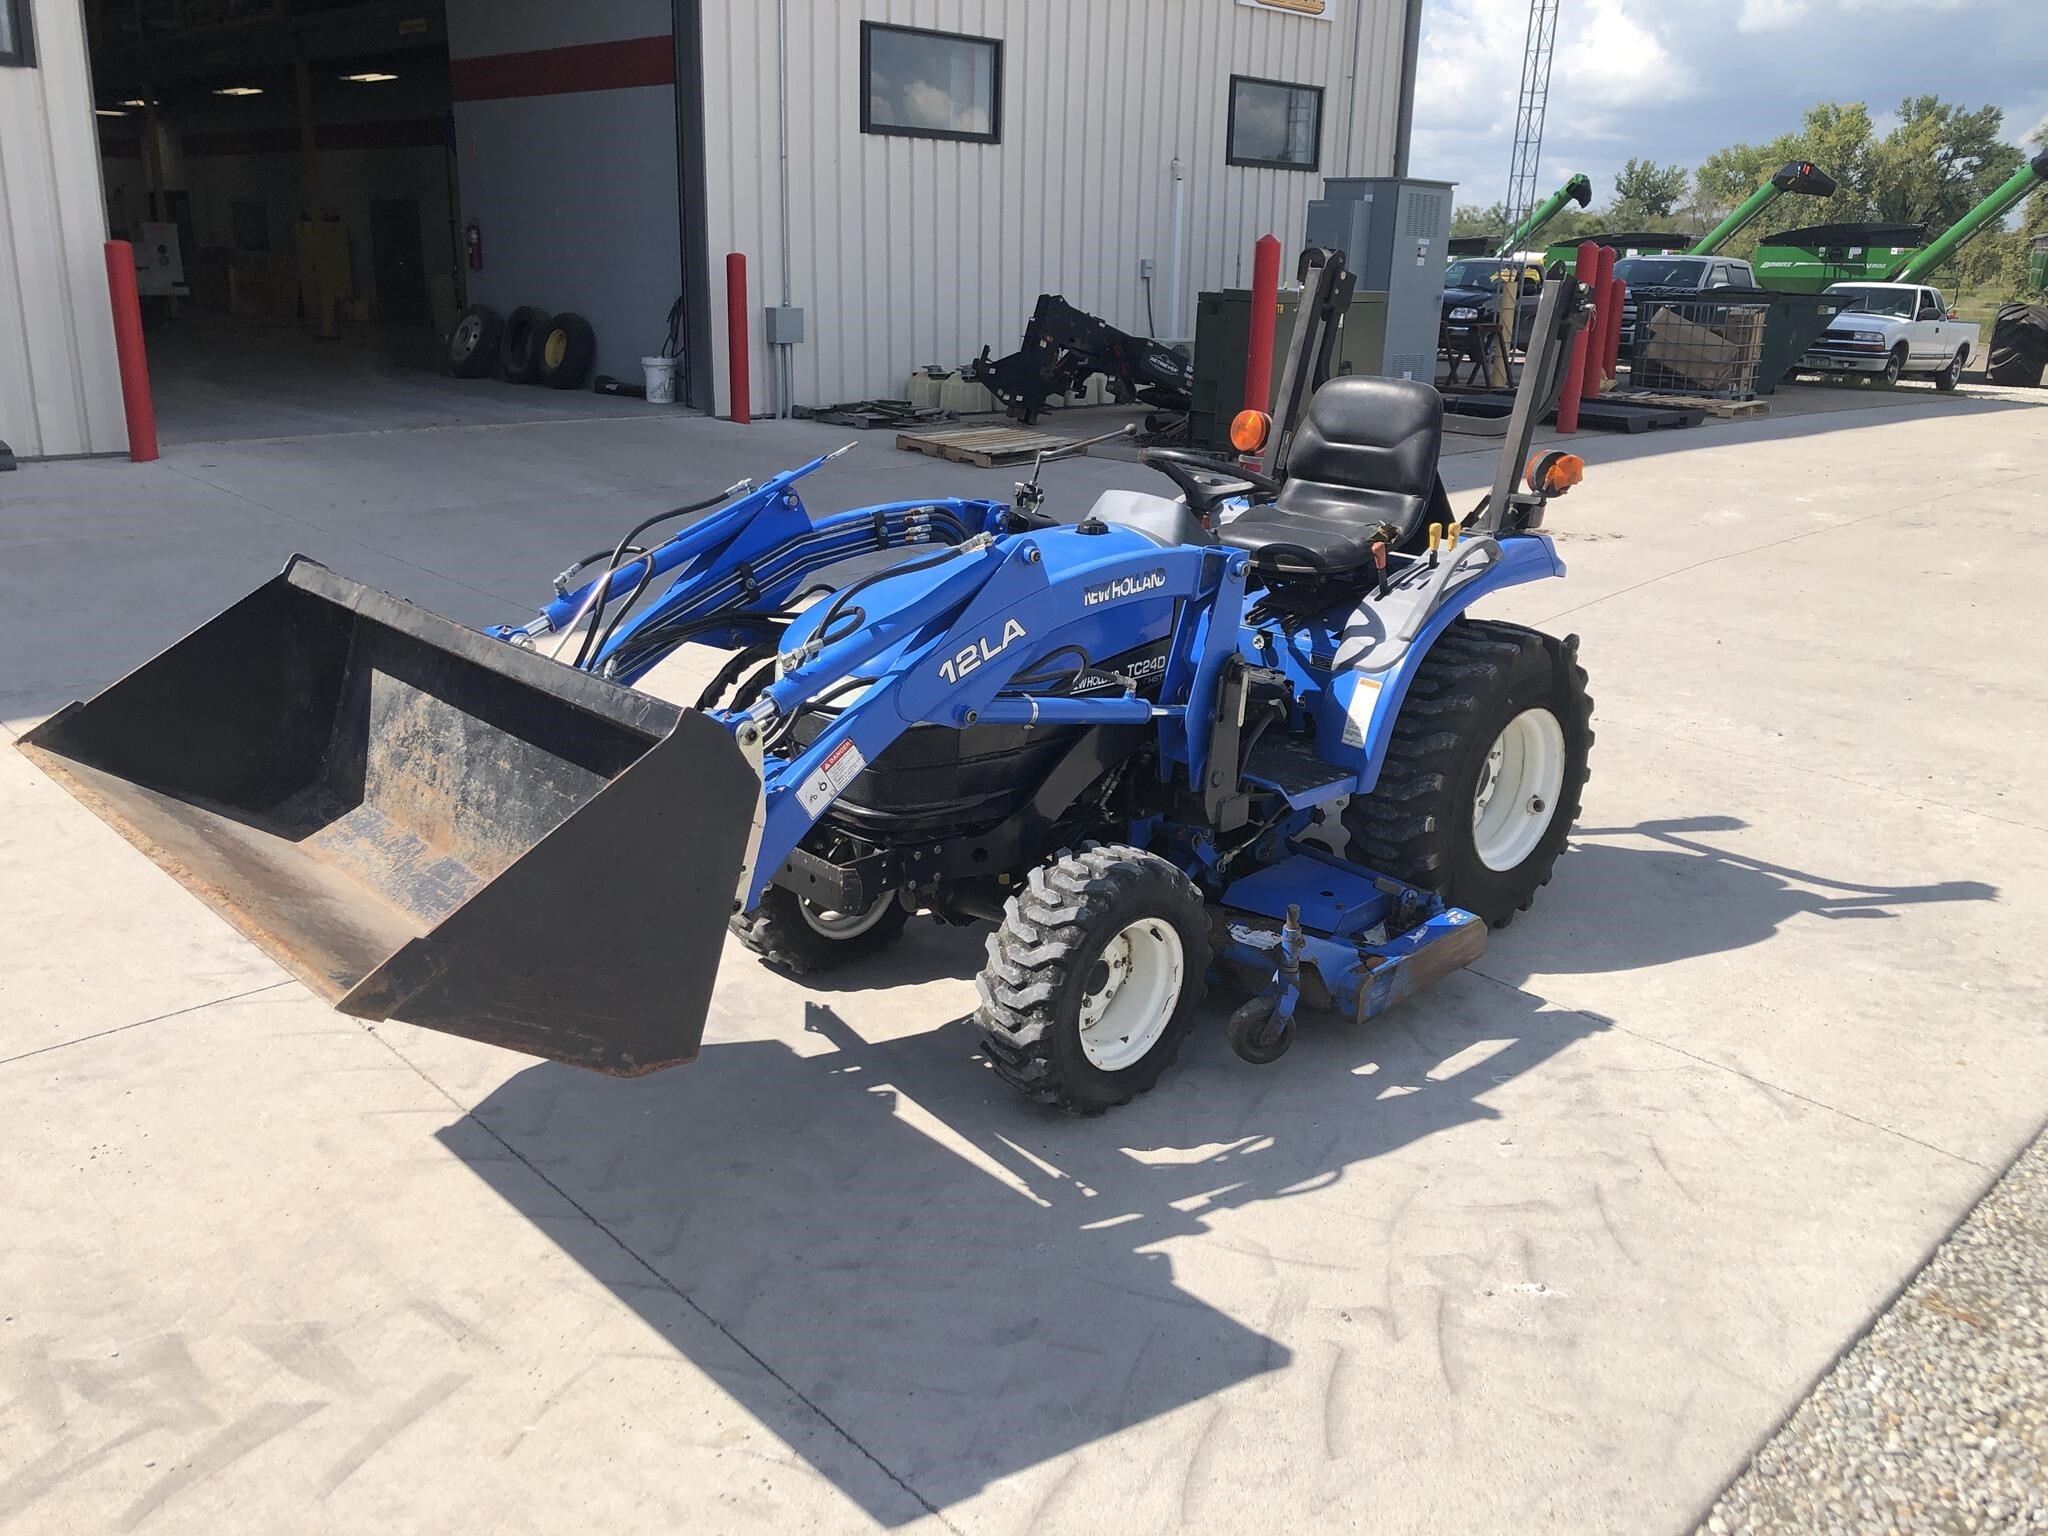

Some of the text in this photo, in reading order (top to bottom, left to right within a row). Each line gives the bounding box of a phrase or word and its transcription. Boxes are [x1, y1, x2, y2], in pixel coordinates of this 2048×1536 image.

[1084, 570, 1165, 606] NEW HOLLAND
[938, 617, 1028, 685] 12LA
[1127, 655, 1166, 677] TC24D
[830, 740, 852, 764] DANGER
